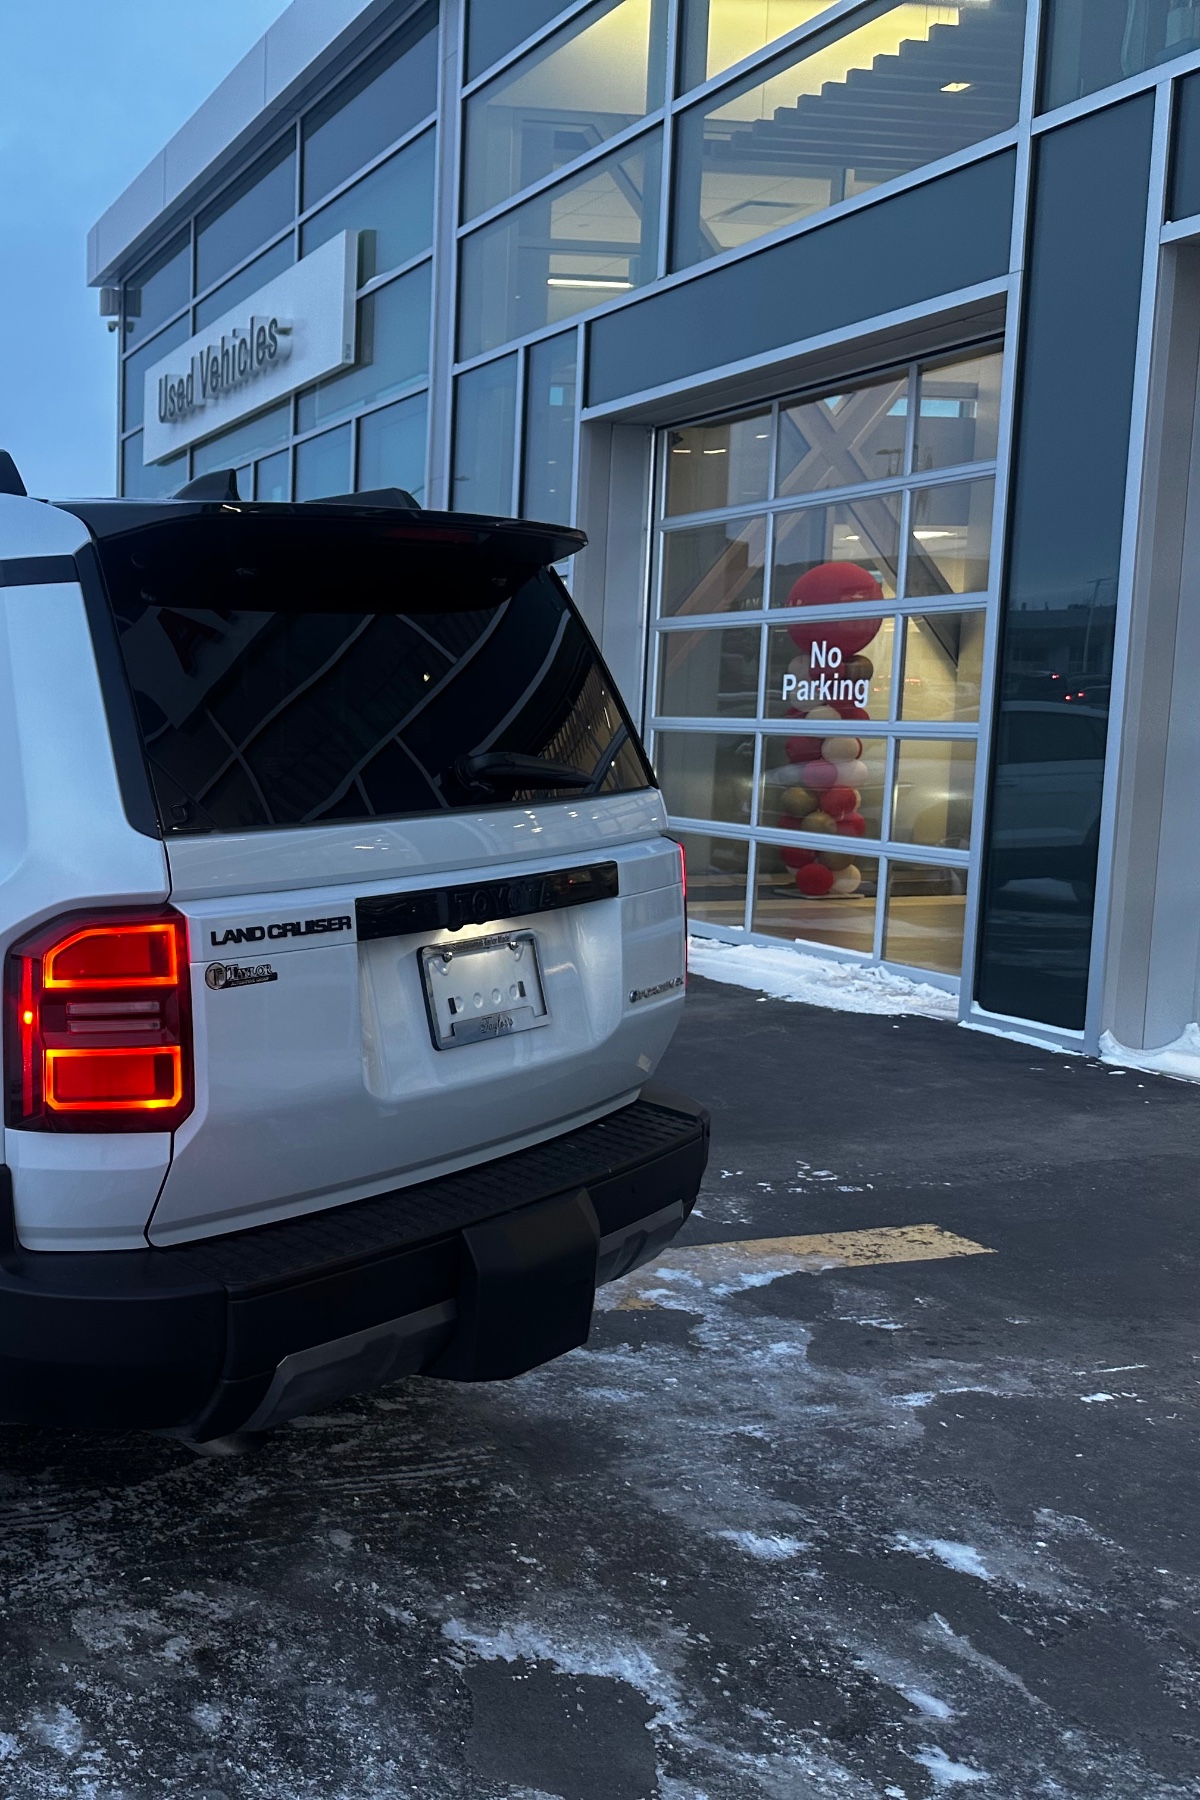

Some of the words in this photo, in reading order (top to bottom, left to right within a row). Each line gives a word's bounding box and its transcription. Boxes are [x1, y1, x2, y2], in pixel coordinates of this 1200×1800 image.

[158, 356, 194, 423] Used
[199, 315, 279, 399] Vehicles
[810, 641, 842, 669] No
[782, 673, 869, 708] Parking
[454, 880, 557, 921] TOYOTA
[211, 926, 265, 946] LAND
[267, 916, 352, 939] CRUISER
